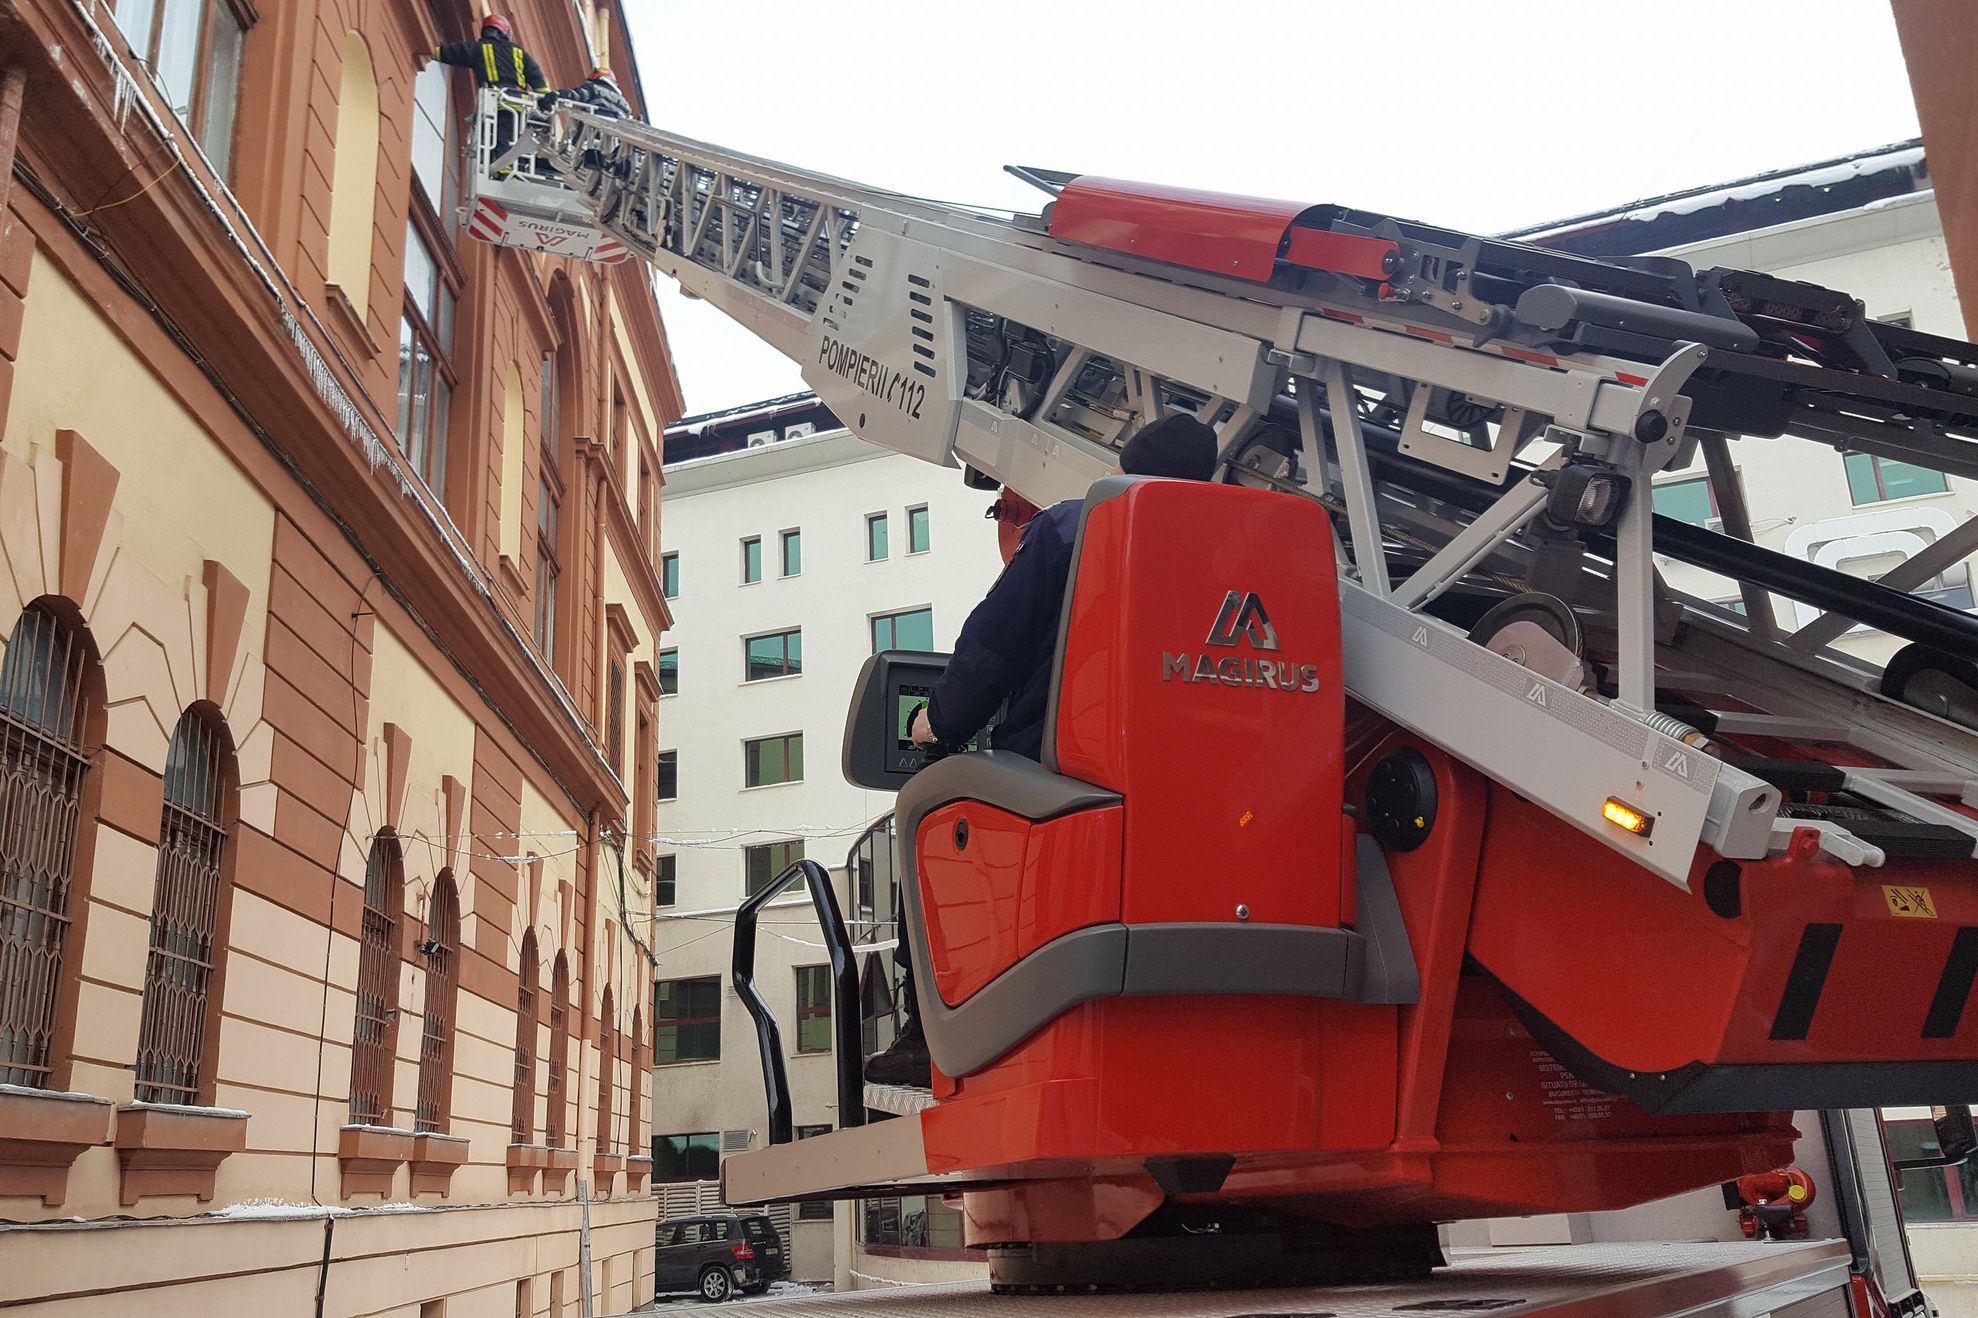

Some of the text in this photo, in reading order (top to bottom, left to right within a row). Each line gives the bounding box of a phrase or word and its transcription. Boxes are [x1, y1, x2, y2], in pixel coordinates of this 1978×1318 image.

[518, 219, 590, 239] MAGIRUS
[818, 334, 926, 420] POMPIERII 112
[1161, 650, 1320, 693] MAGIRUS
